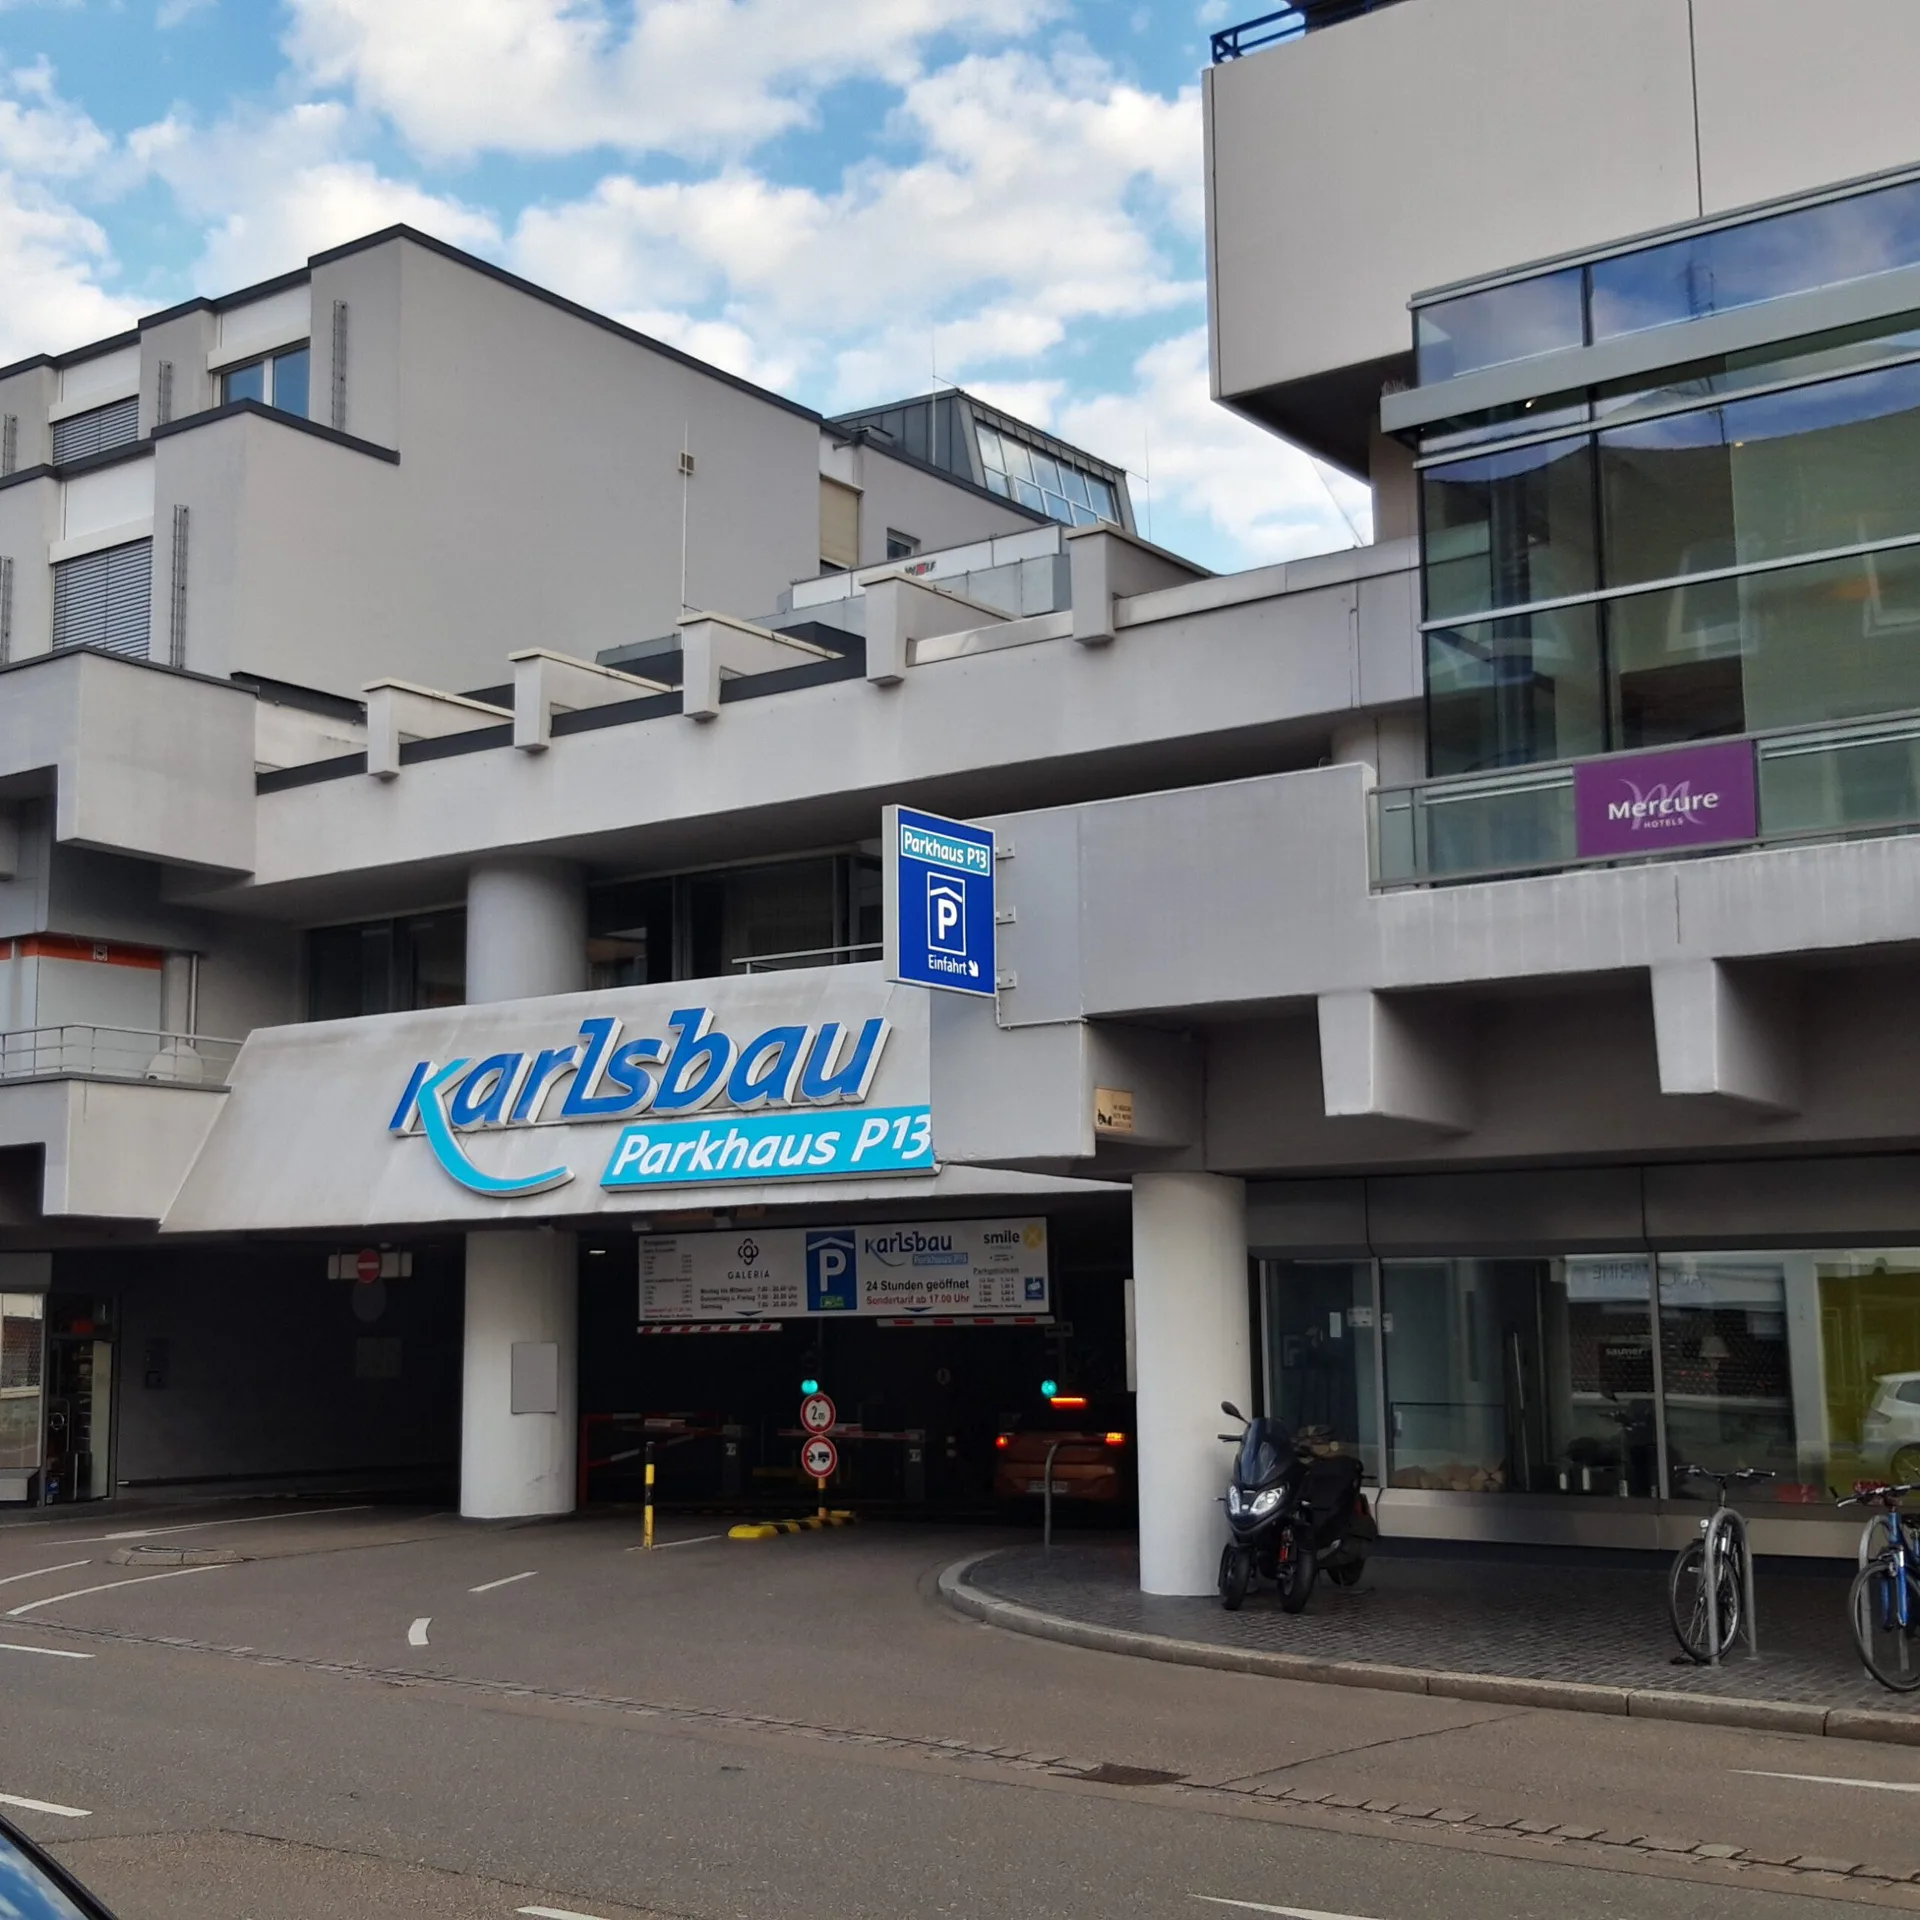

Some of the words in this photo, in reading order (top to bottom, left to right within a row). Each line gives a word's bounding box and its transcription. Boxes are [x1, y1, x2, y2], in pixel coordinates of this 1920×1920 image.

[1608, 792, 1719, 820] Mercure
[1644, 817, 1684, 829] HOTELS
[904, 831, 964, 864] Parkhaus
[967, 848, 987, 869] P13
[937, 898, 958, 940] P
[928, 954, 967, 976] Einfahrt
[389, 1007, 891, 1197] Karlsbau
[612, 1127, 841, 1177] Parkhaus
[850, 1114, 932, 1162] P13
[865, 1231, 952, 1267] Karlsbau
[983, 1230, 1020, 1244] smile
[727, 1270, 770, 1280] GALERIA
[819, 1249, 847, 1292] P
[866, 1281, 878, 1291] 24
[881, 1280, 923, 1291] Stunden
[926, 1278, 970, 1292] geöffnet
[866, 1295, 914, 1305] Sondertarif
[916, 1295, 927, 1303] ab
[929, 1294, 952, 1303] 17.00
[954, 1294, 970, 1303] Uhr
[811, 1405, 818, 1420] 2
